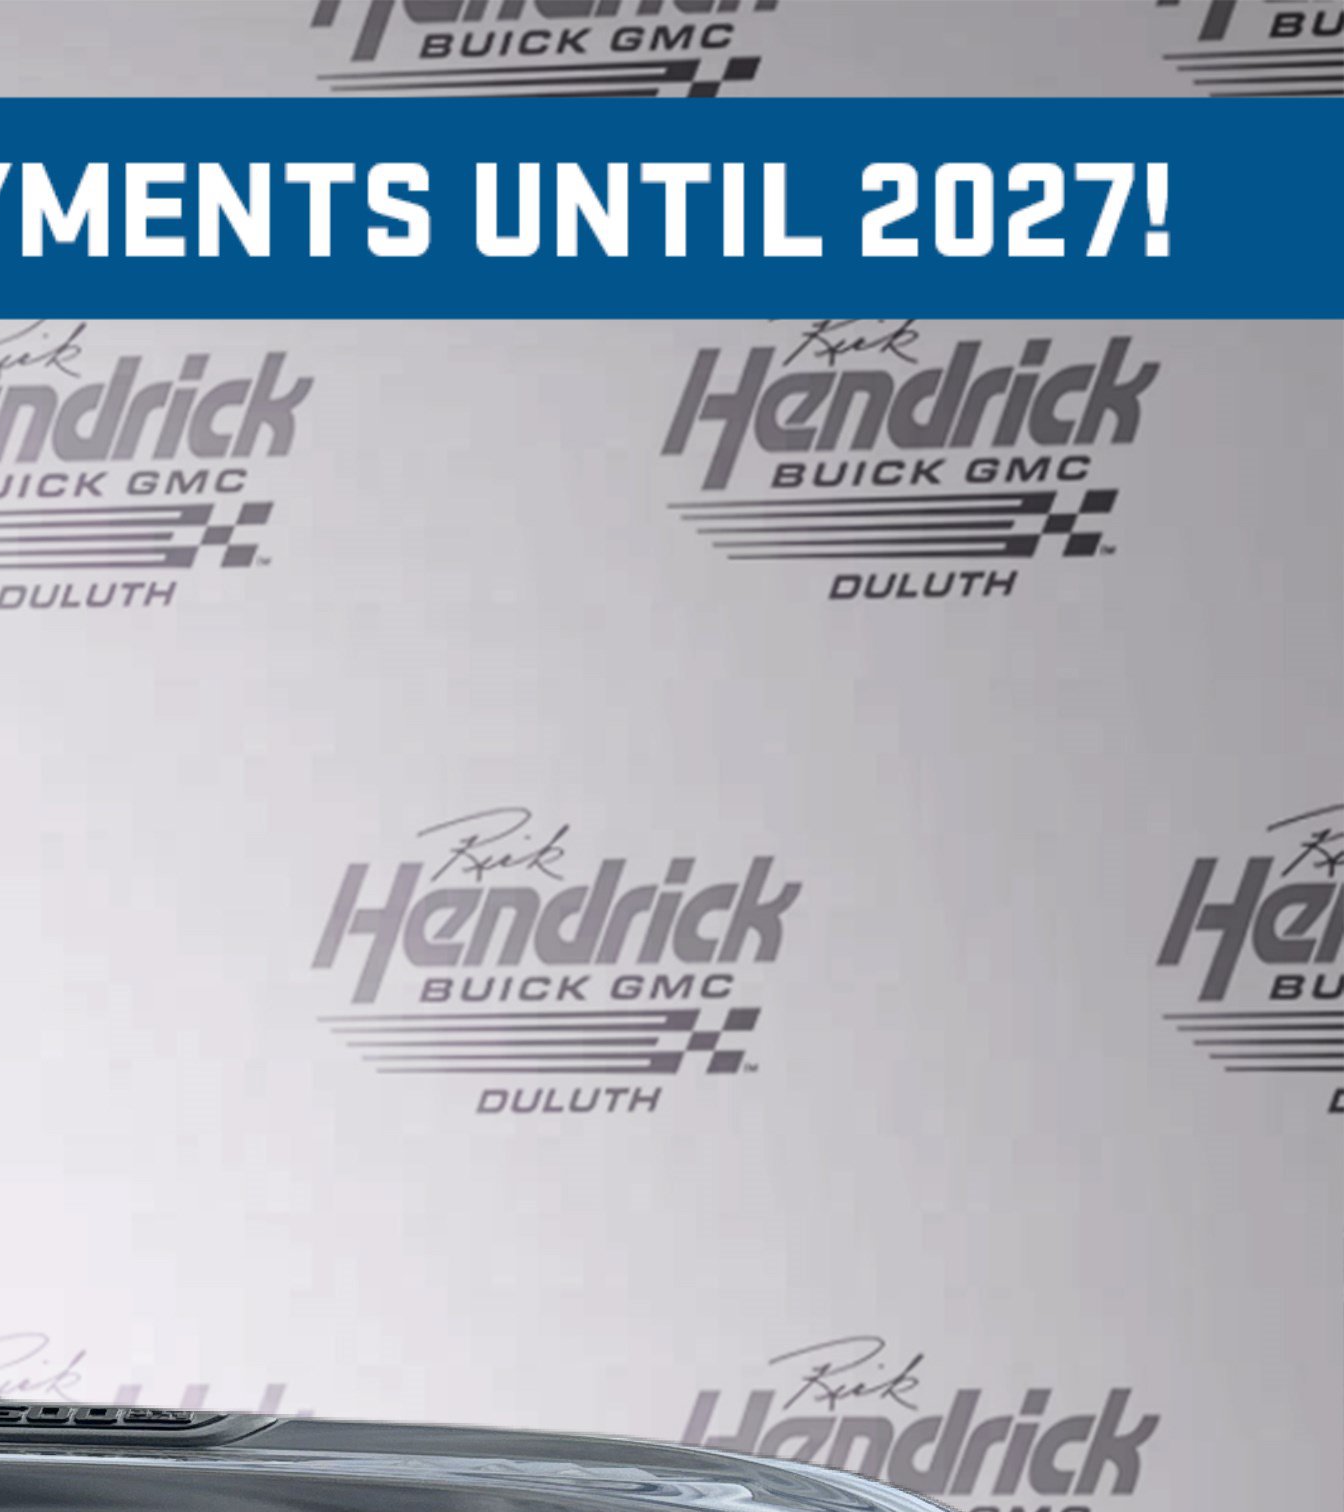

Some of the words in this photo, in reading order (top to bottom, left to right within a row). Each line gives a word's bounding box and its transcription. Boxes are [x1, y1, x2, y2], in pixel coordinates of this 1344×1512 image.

[419, 28, 591, 59] BUICK
[610, 23, 734, 52] GMC
[661, 336, 1160, 490] Hendrick
[126, 468, 248, 496] GMC
[771, 458, 946, 488] BUICK
[965, 455, 1091, 484] GMC
[828, 570, 1018, 600] DULUTH
[312, 856, 802, 1003] Hendrick
[419, 975, 590, 1003] BUICK
[610, 973, 734, 1000] GMC
[476, 1087, 662, 1114] DULUTH
